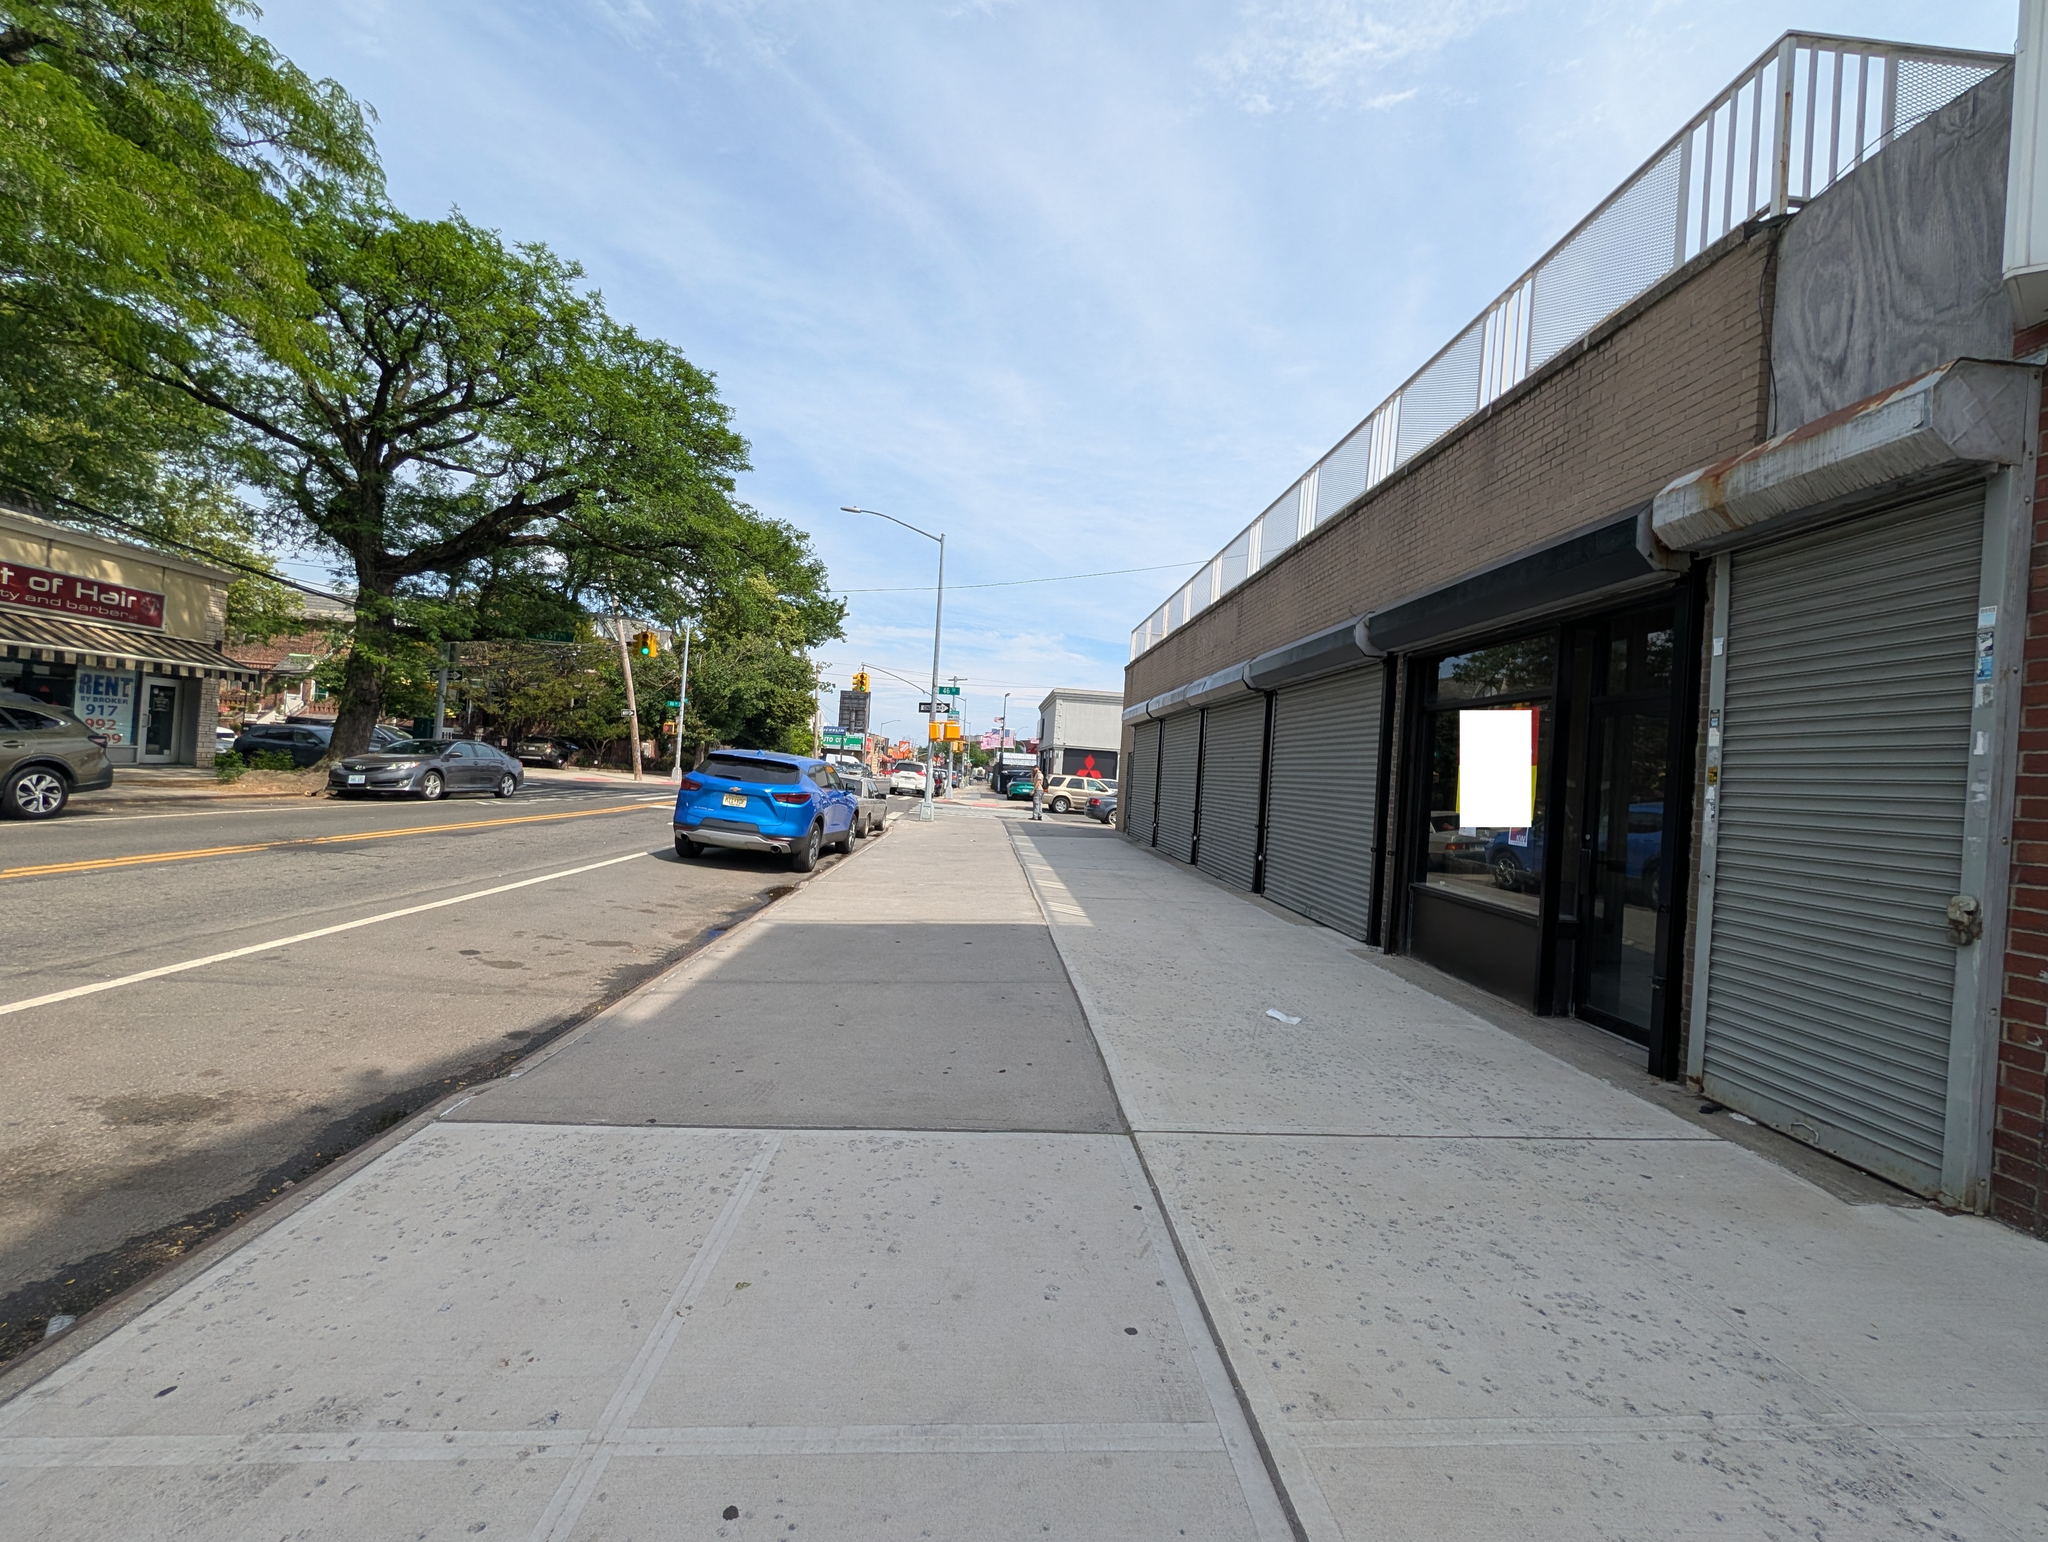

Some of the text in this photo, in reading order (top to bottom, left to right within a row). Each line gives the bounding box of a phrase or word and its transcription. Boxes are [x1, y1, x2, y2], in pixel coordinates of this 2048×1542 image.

[29, 576, 63, 594] of
[76, 582, 137, 608] Hair
[25, 595, 61, 606] and
[66, 600, 128, 617] barber
[79, 674, 133, 697] RENT
[93, 697, 129, 705] BROKER
[85, 704, 118, 716] 917
[84, 718, 117, 731] 992
